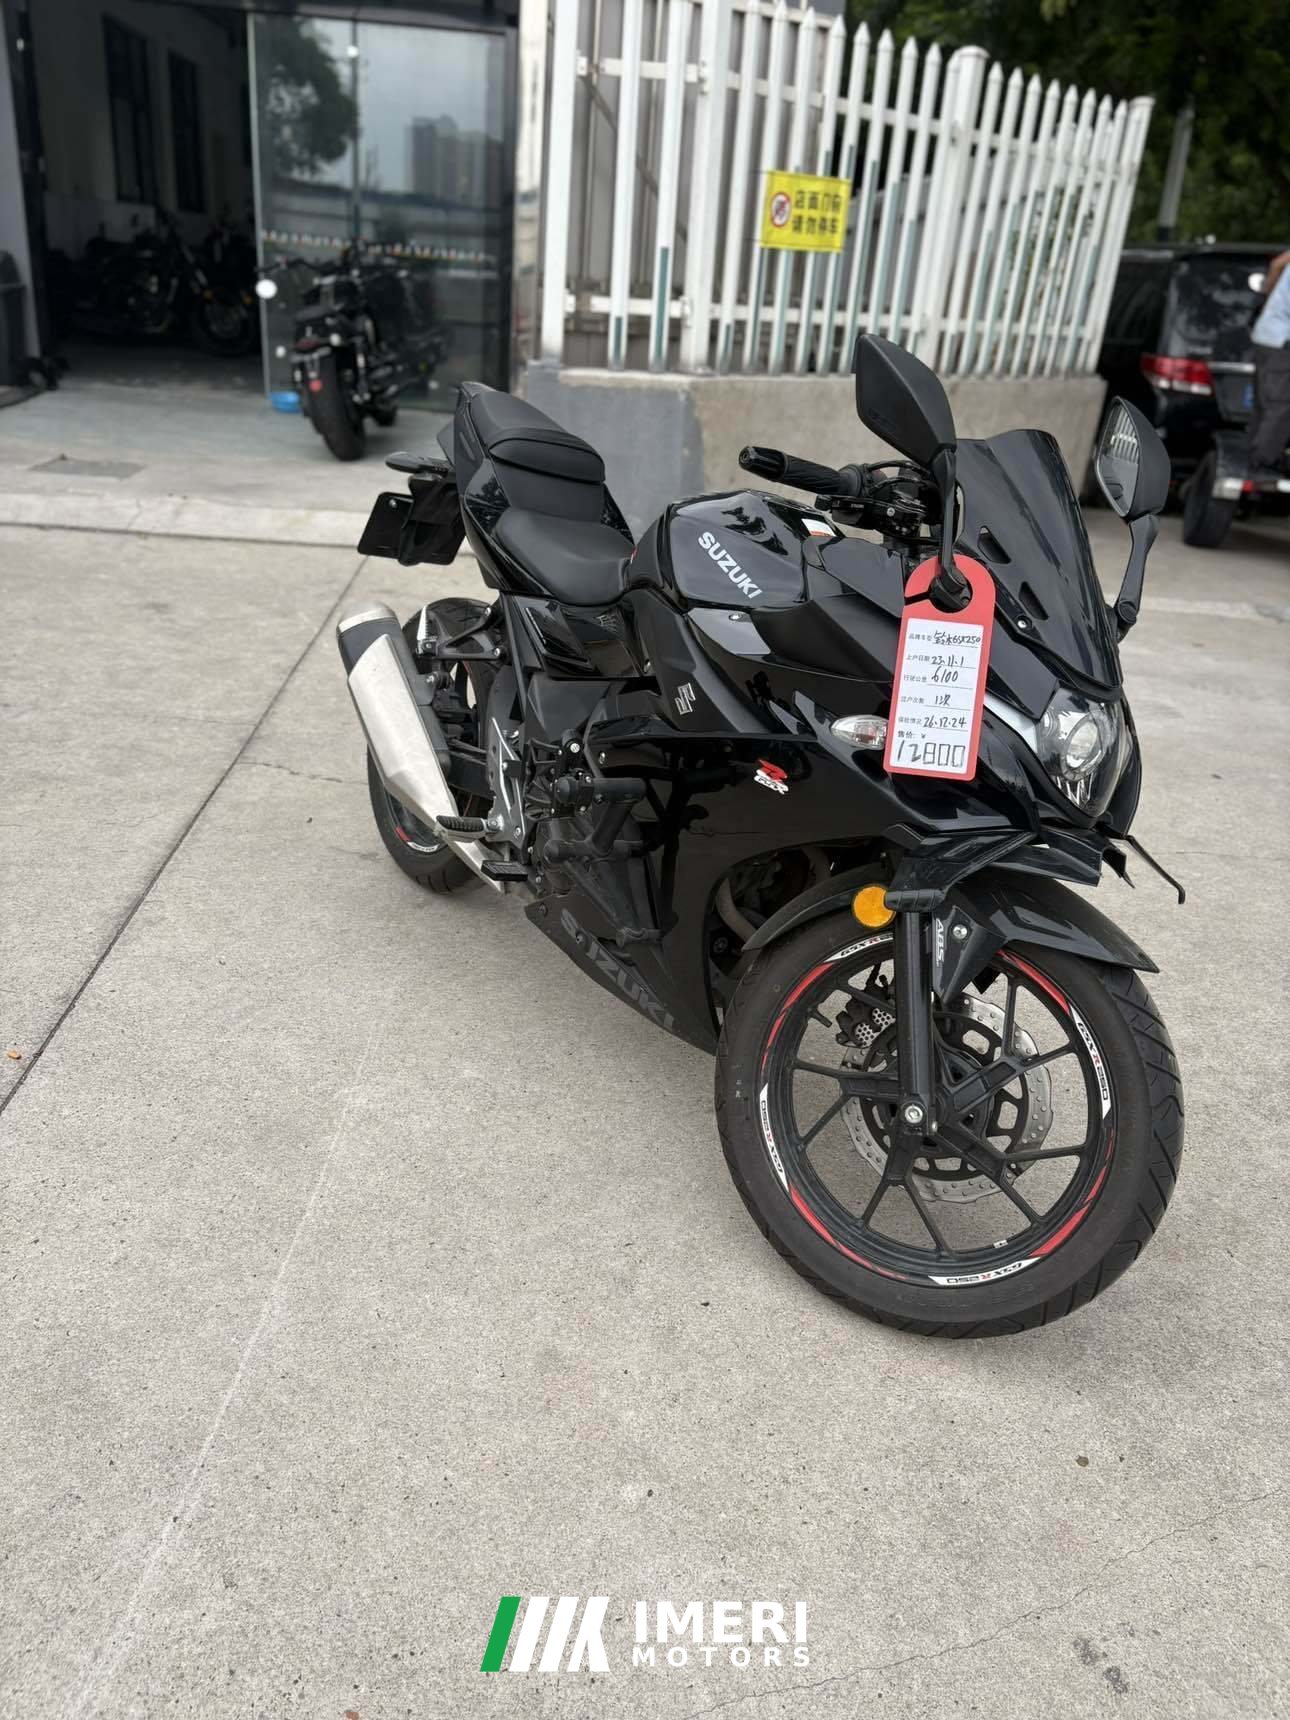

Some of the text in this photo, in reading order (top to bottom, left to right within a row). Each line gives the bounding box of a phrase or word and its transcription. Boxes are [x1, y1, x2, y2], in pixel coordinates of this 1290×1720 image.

[792, 215, 838, 235] 请勿停车
[698, 532, 763, 599] SUZUKI
[906, 654, 931, 662] 上户日期
[931, 665, 959, 683] 6100
[897, 740, 967, 768] 12800
[935, 917, 945, 967] ABS
